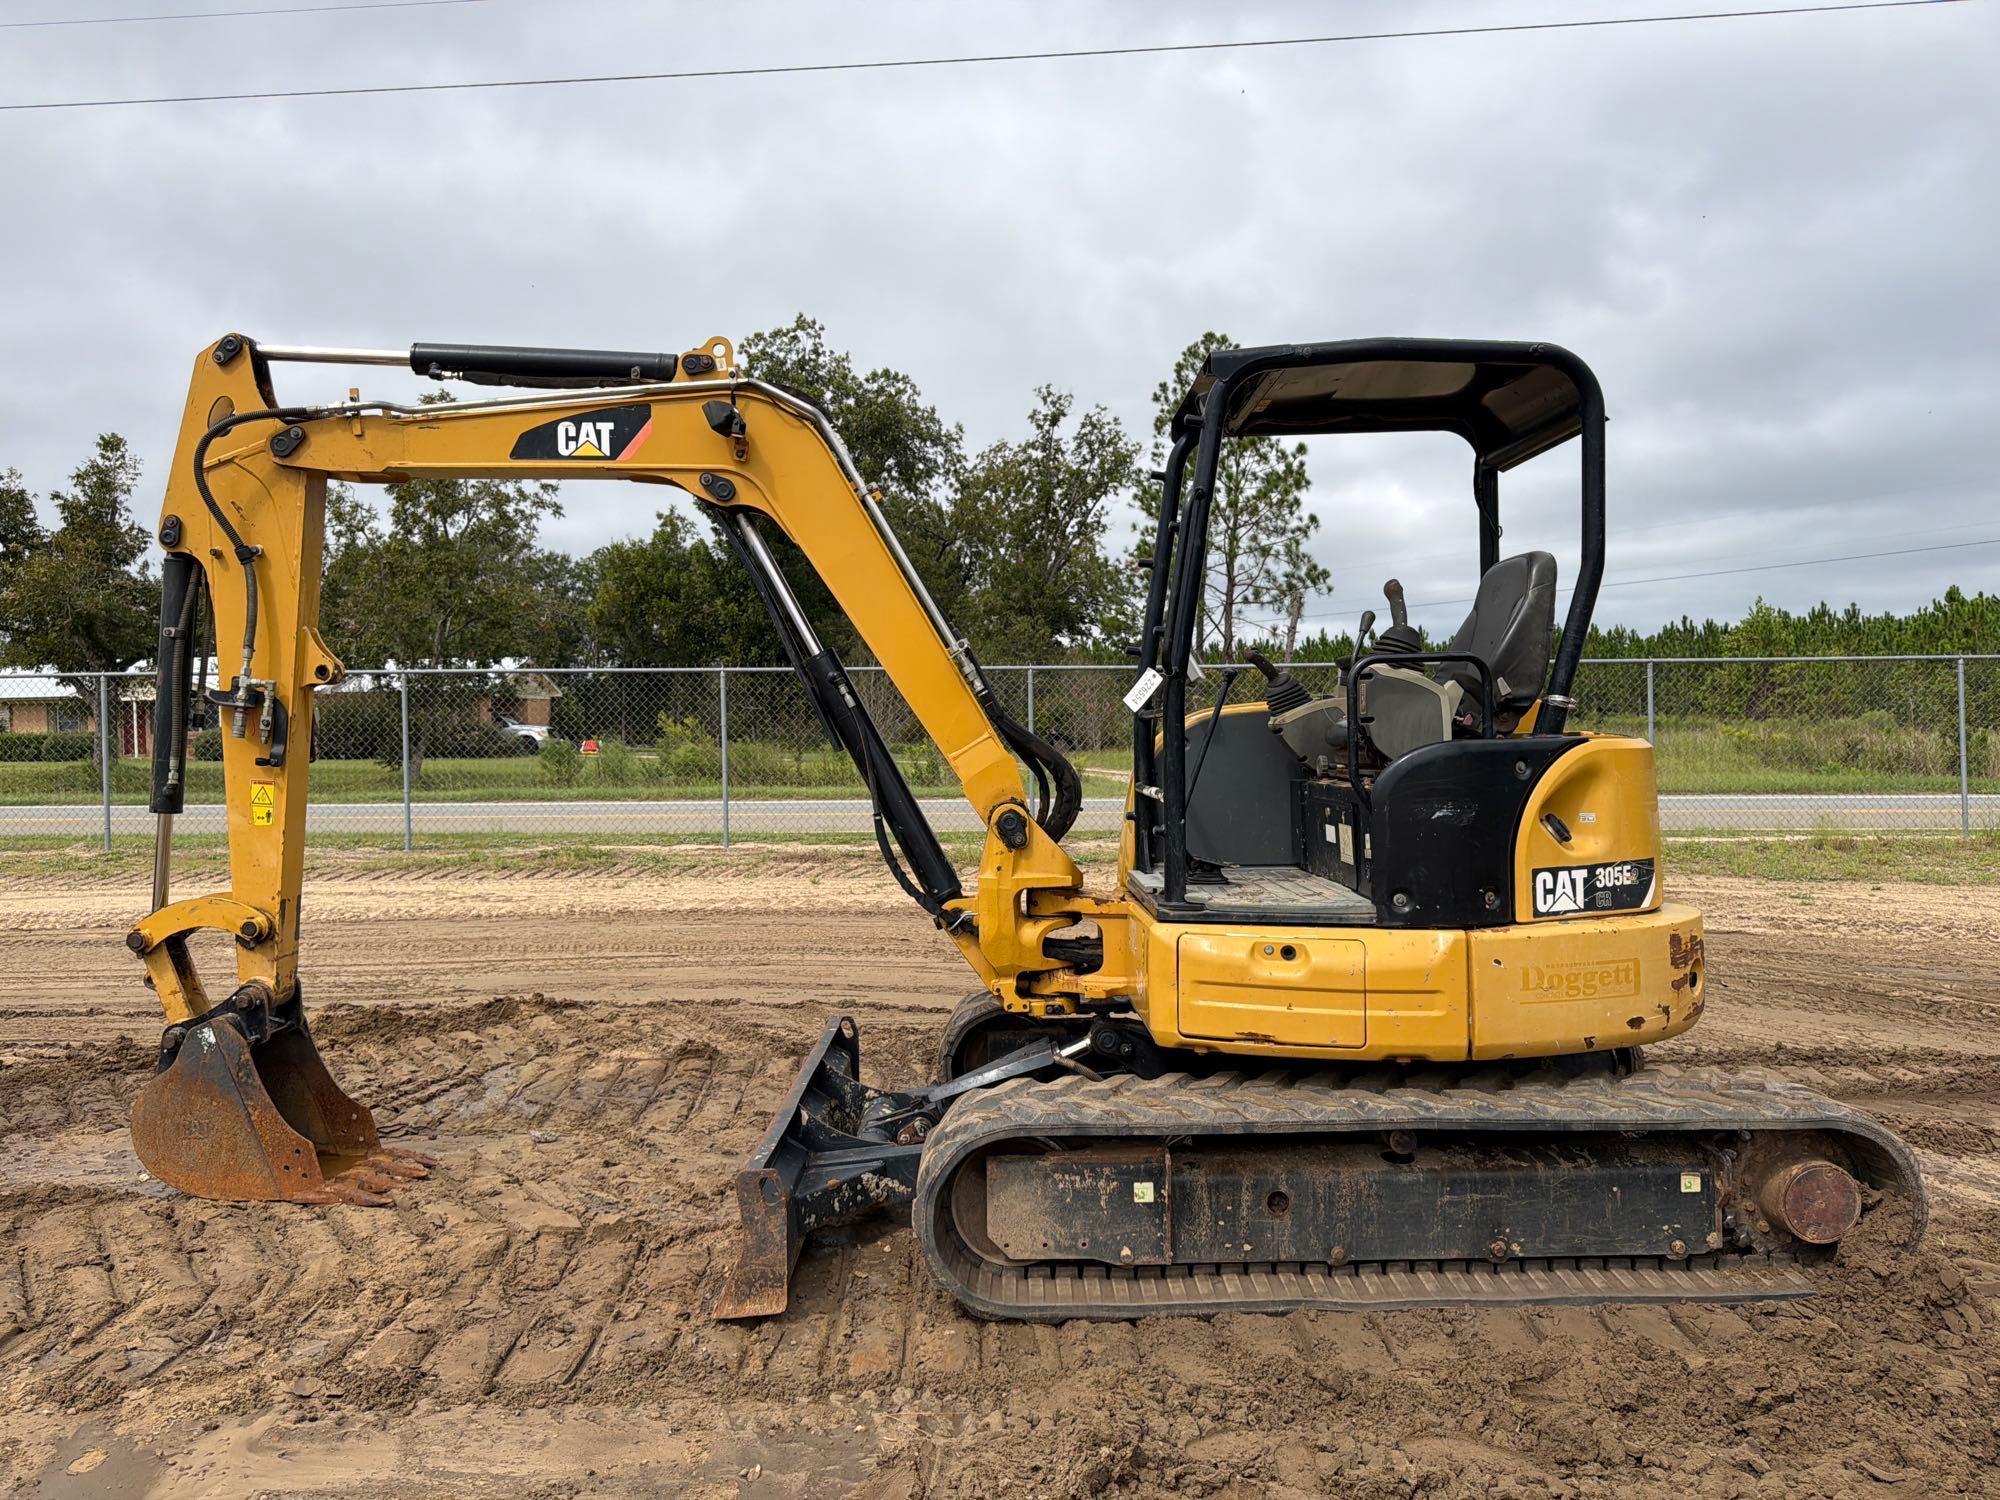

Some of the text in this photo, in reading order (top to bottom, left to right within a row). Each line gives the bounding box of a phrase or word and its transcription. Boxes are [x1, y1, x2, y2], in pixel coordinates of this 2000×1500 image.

[557, 421, 615, 457] CAT
[1535, 868, 1588, 913] CAT
[1595, 891, 1613, 909] CR
[1519, 963, 1634, 998] Doggett
